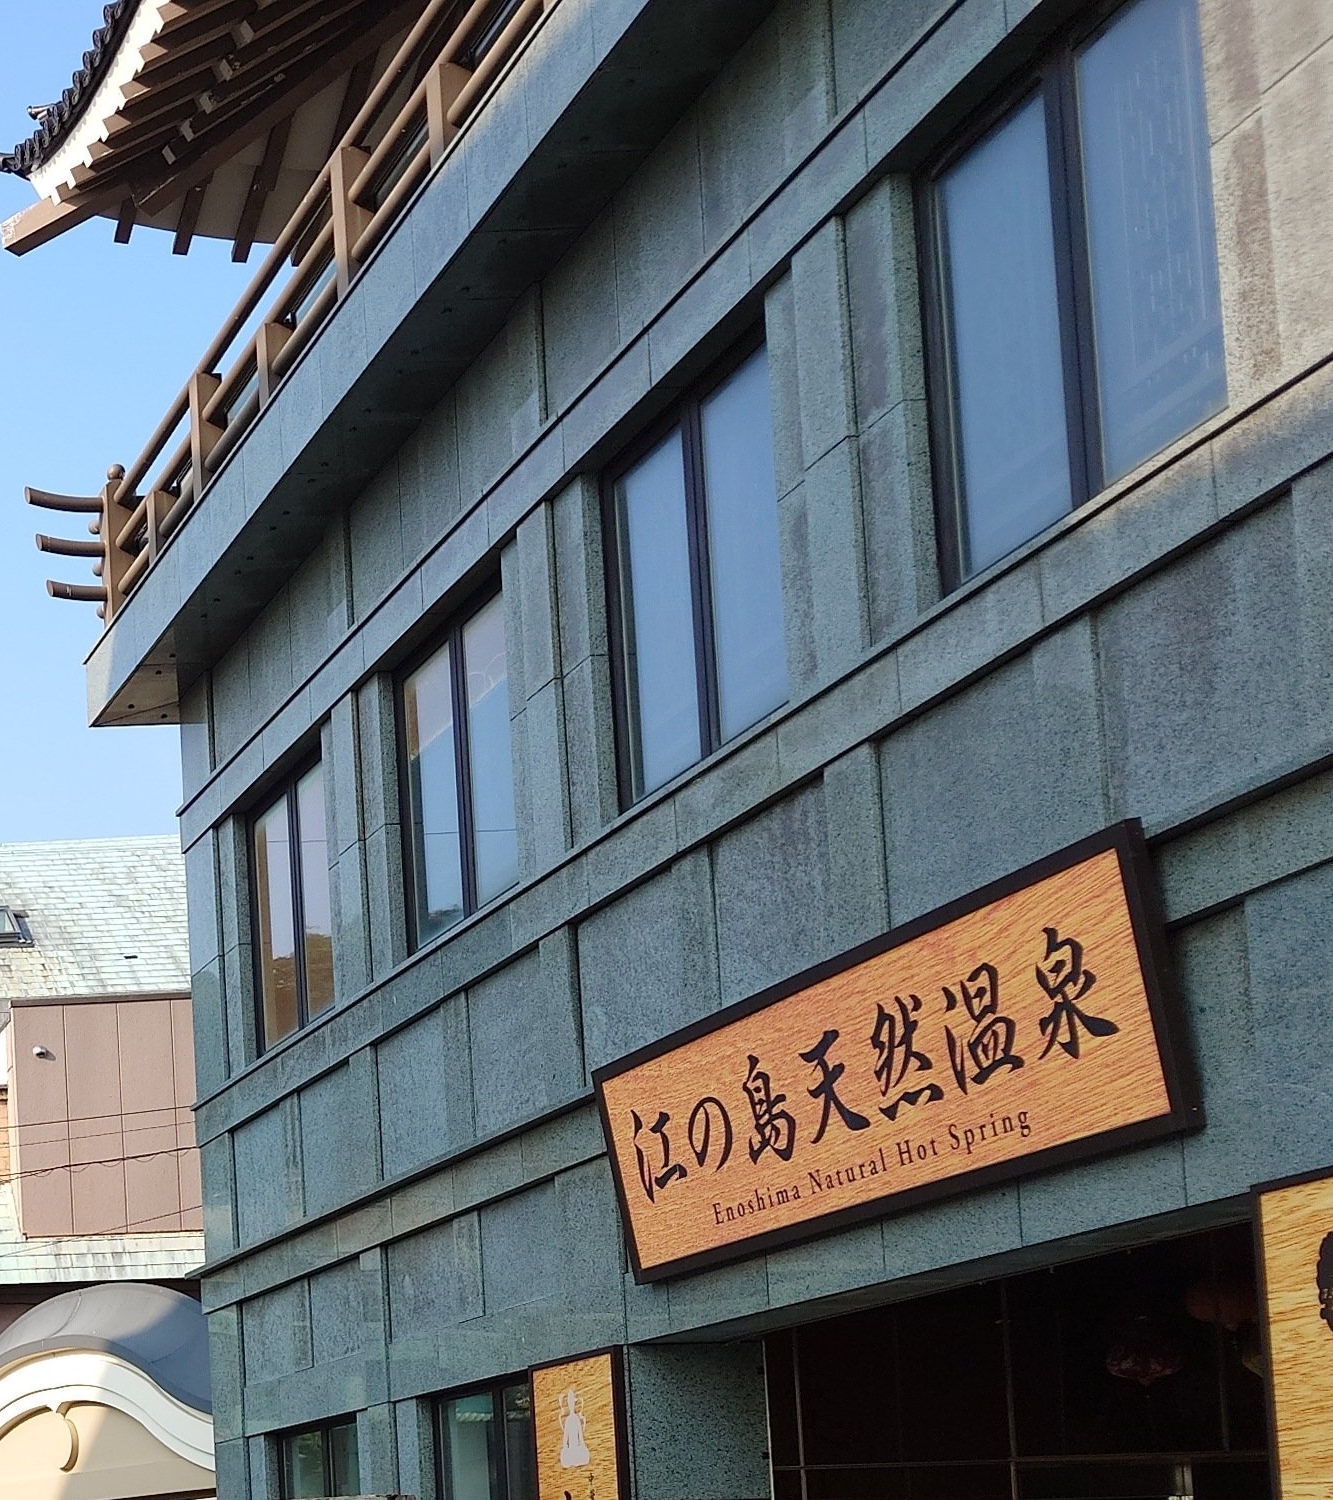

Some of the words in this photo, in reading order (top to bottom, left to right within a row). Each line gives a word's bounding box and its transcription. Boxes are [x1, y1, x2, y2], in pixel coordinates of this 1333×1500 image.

[630, 926, 1121, 1205] 江の島天然温泉
[712, 1186, 802, 1226] Enoshima
[807, 1147, 888, 1196] Natural
[895, 1138, 939, 1168] Hot
[947, 1109, 1032, 1155] Spring
